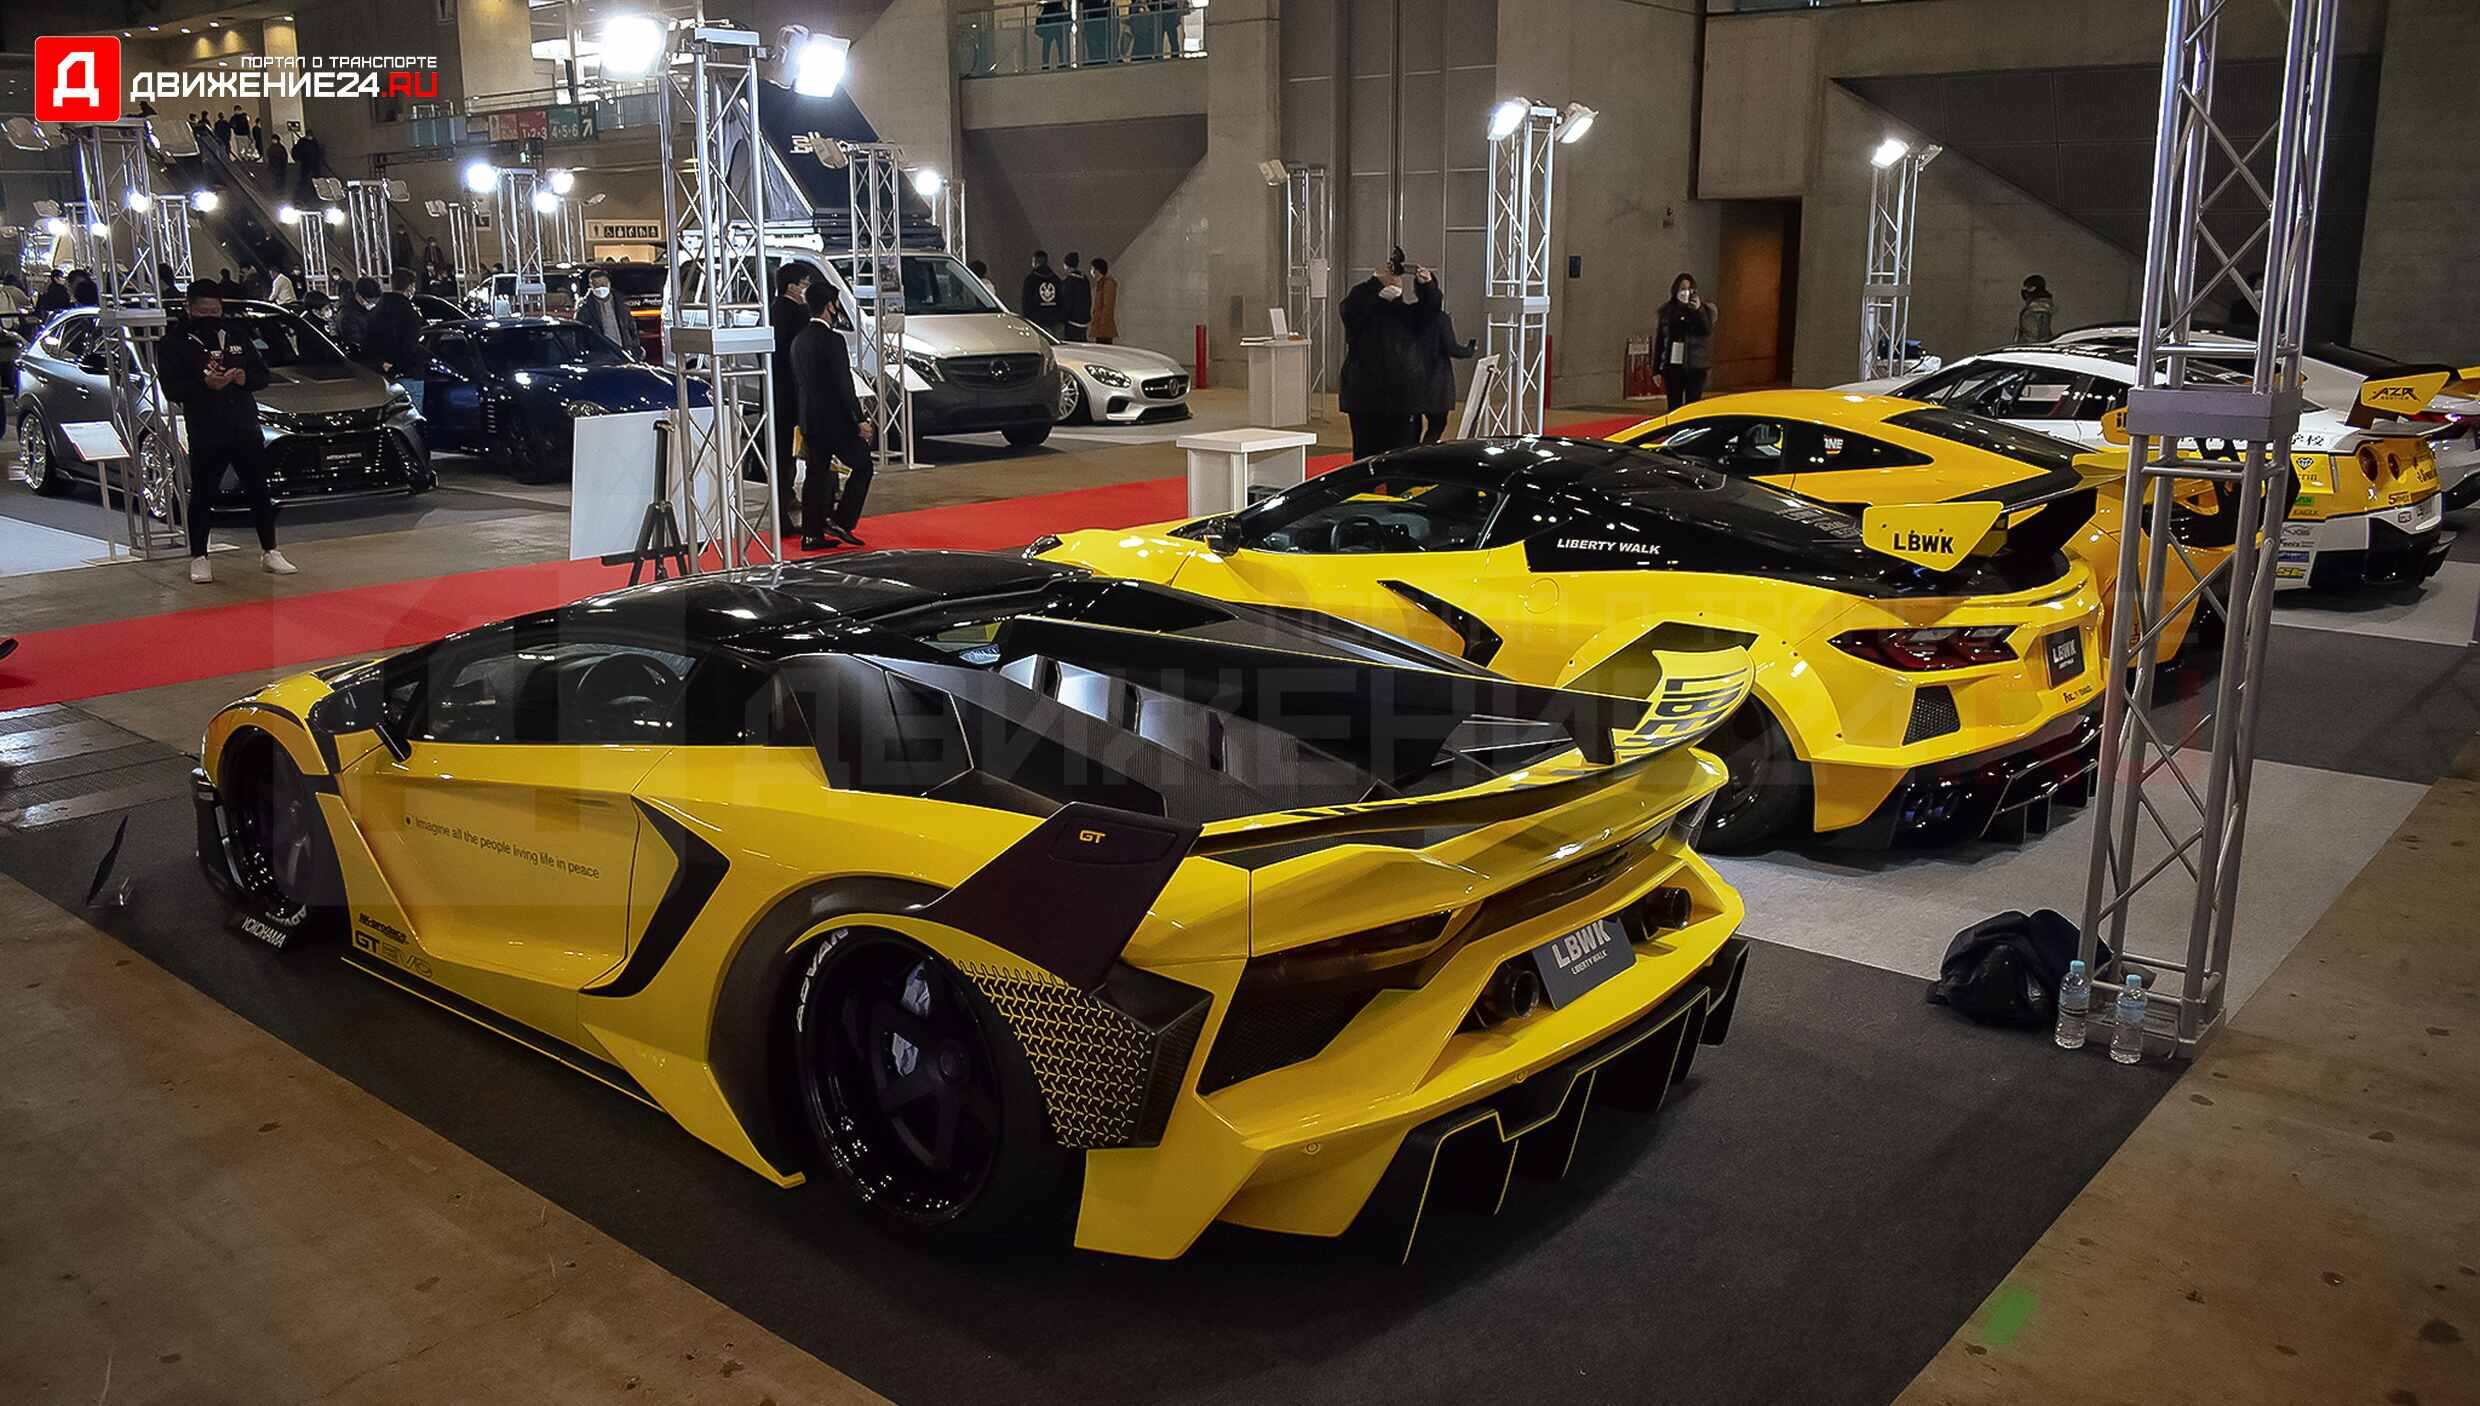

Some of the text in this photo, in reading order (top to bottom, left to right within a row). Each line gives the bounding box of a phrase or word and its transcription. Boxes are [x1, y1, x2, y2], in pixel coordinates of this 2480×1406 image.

[1557, 538, 1661, 555] LIBERTY WALK
[1893, 532, 1954, 554] LBWK
[1079, 830, 1106, 843] GT
[480, 838, 511, 855] people
[568, 863, 600, 879] peace
[355, 930, 381, 953] GT
[1552, 919, 1611, 969] LBWK
